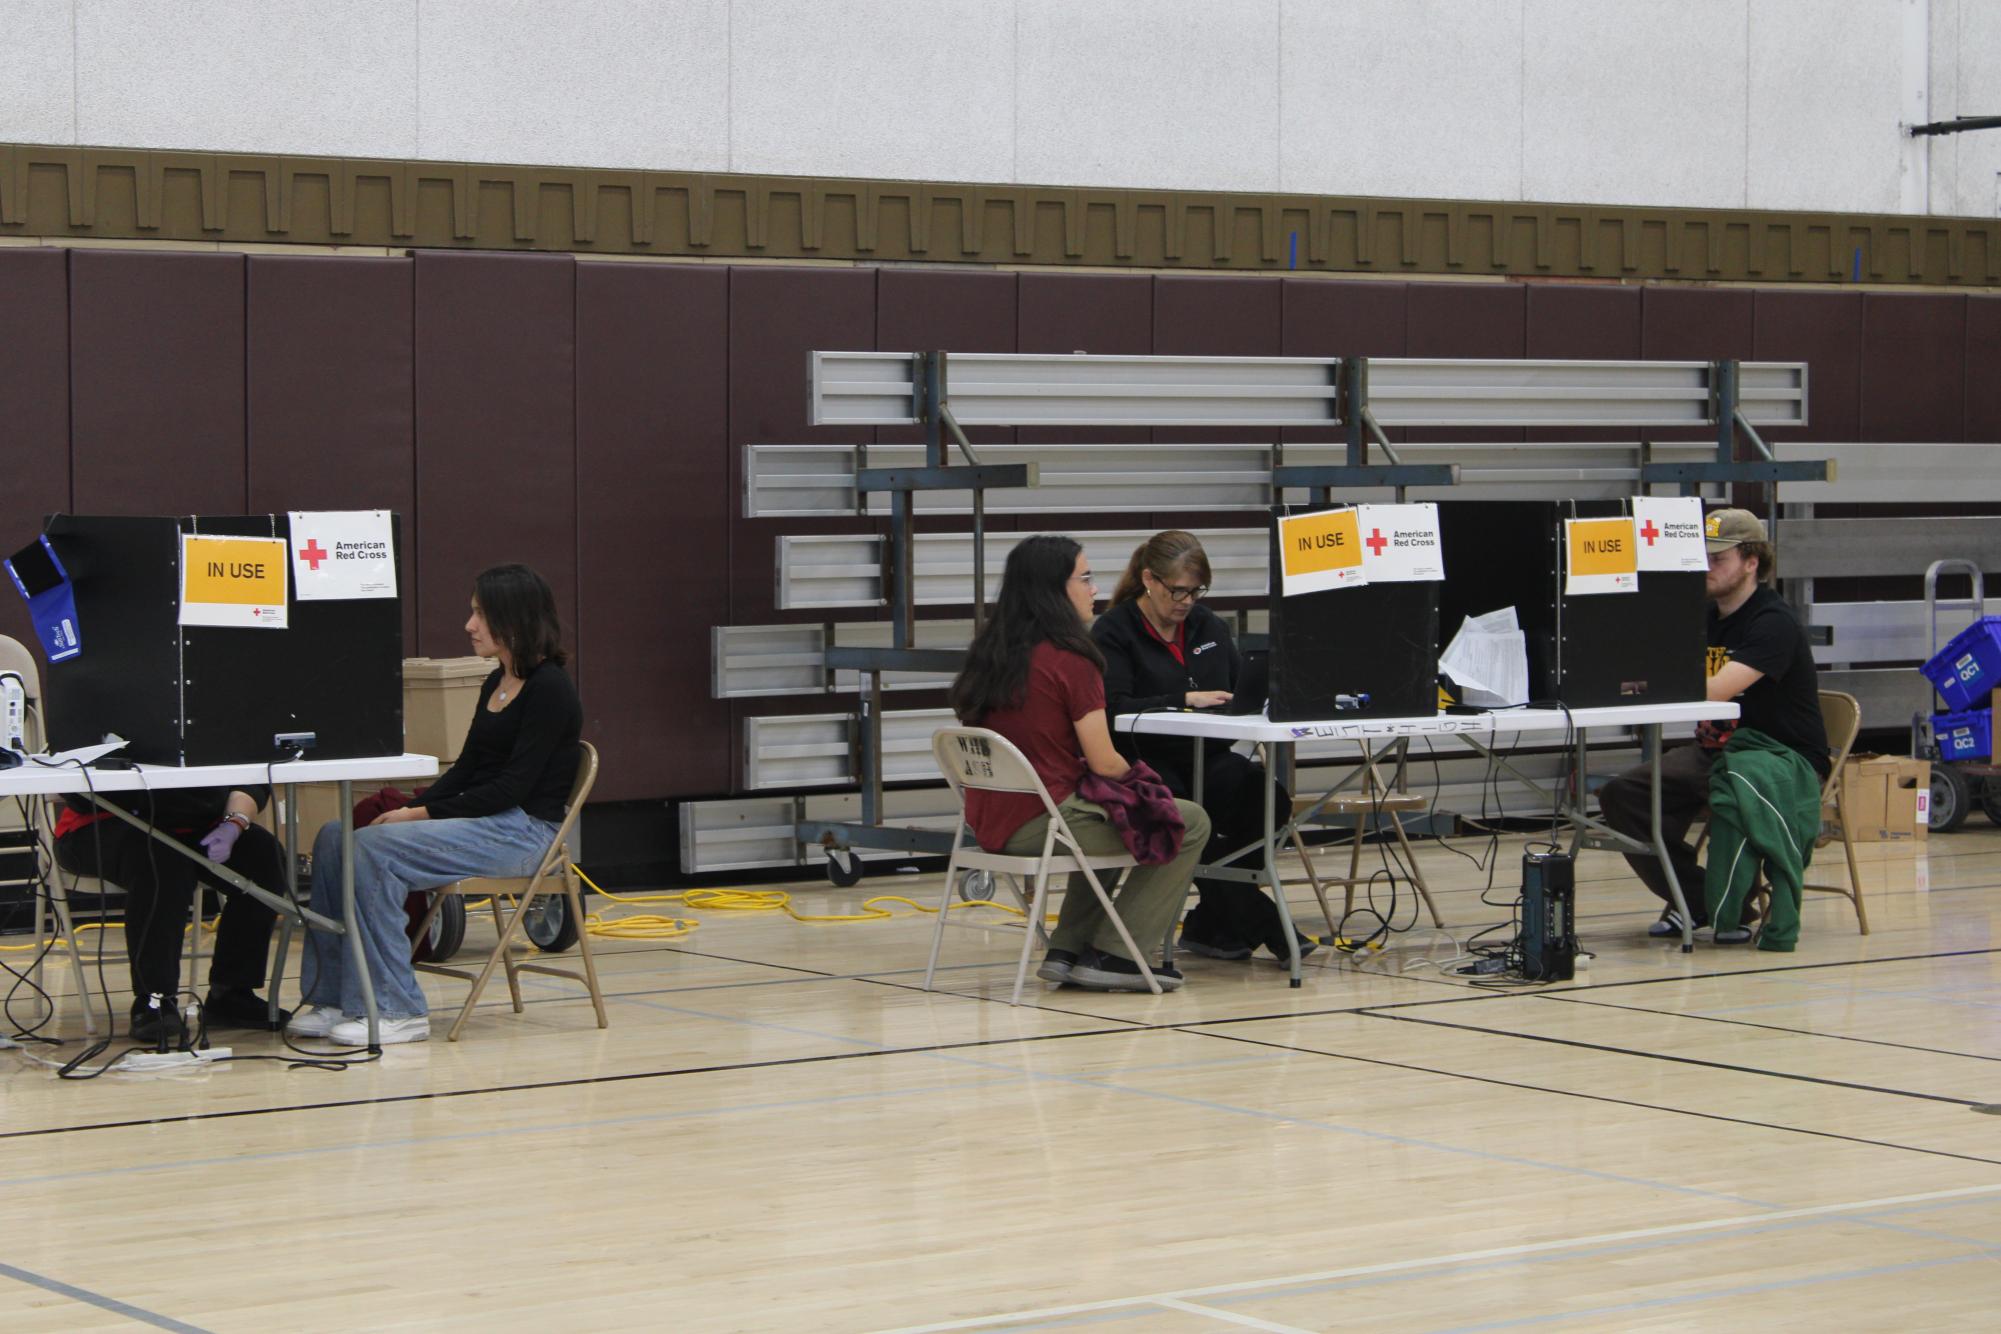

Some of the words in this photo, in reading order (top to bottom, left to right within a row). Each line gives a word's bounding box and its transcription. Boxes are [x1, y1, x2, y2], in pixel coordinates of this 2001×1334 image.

[1394, 530, 1433, 538] American
[1664, 530, 1678, 538] Red
[1679, 530, 1700, 538] Cross
[335, 541, 386, 550] American
[1298, 537, 1312, 551] IN
[1316, 532, 1345, 548] USE
[1394, 539, 1409, 547] Red
[1411, 538, 1435, 547] Cross
[1583, 541, 1596, 553] IN
[1598, 539, 1622, 553] USE
[336, 551, 355, 560] Red
[358, 550, 387, 560] Cross
[207, 562, 224, 577] IN
[230, 563, 265, 579] USE
[1960, 663, 1980, 681] QC1
[1954, 737, 1975, 750] QC2
